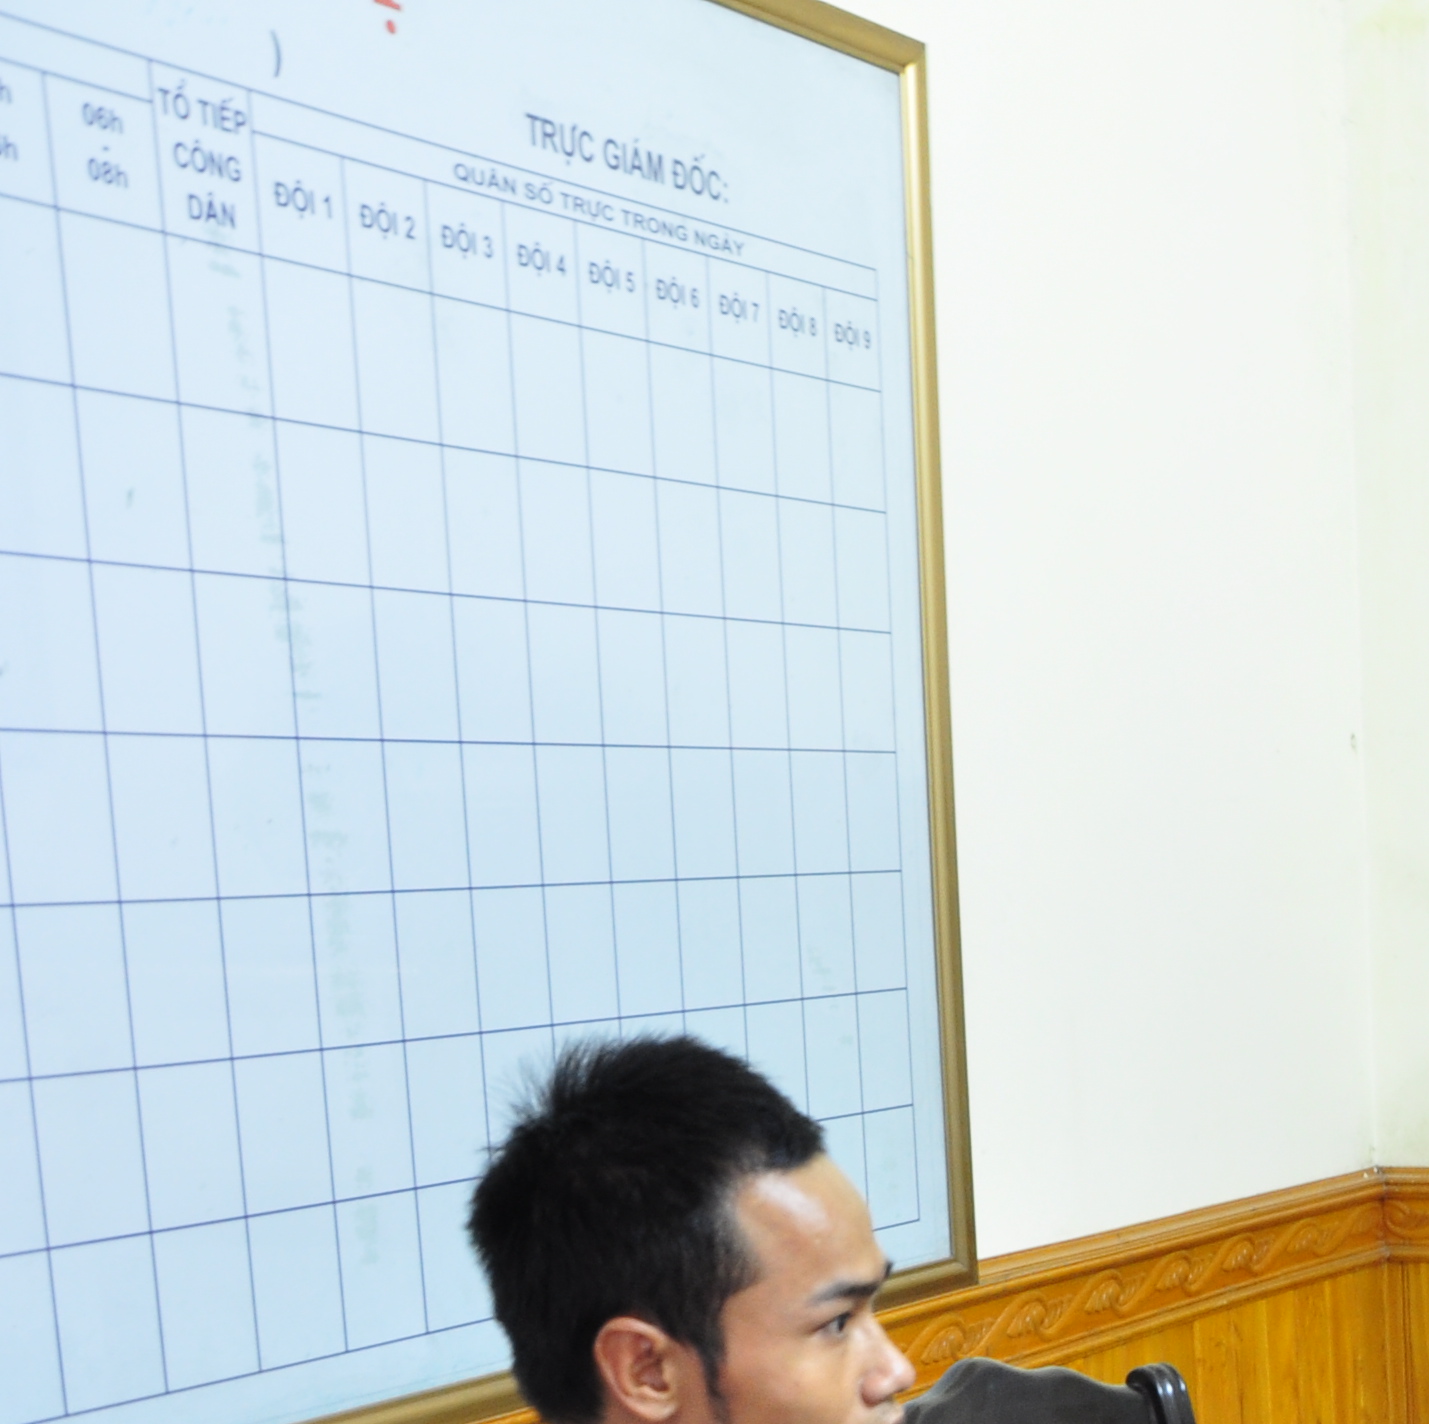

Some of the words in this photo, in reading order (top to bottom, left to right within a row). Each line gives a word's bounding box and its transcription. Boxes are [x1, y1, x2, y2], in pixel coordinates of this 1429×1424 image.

[82, 102, 124, 135] 06h
[157, 79, 190, 121] TỔ
[197, 98, 248, 134] TIẾP
[87, 156, 129, 190] 08h
[173, 141, 242, 184] CÔNG
[525, 112, 596, 167] TRỰC
[602, 138, 666, 186] GIÁM
[672, 153, 730, 204] ĐỐC:
[188, 191, 237, 230] DÂN
[274, 180, 316, 220] ĐỘI
[324, 195, 333, 219] 1
[453, 162, 518, 196] QUÂN
[524, 180, 554, 205] SỐ
[560, 192, 616, 224] TRỰC
[620, 209, 690, 243] TRONG
[693, 231, 745, 257] NGÀY
[359, 202, 399, 240] ĐỘI
[405, 216, 416, 239] 2
[441, 223, 477, 259] ĐỘI
[483, 235, 494, 258] 3
[516, 243, 551, 277] ĐỘI
[554, 255, 567, 276] 4
[589, 259, 622, 292] ĐỘI
[625, 272, 636, 293] 5
[655, 275, 688, 309] ĐỘI
[690, 287, 700, 309] 6
[719, 292, 749, 322] ĐỘI
[751, 303, 760, 323] 7
[778, 307, 807, 337] ĐỘI
[808, 317, 818, 338] 8
[835, 319, 861, 351] ĐỘI
[862, 331, 872, 351] 9
